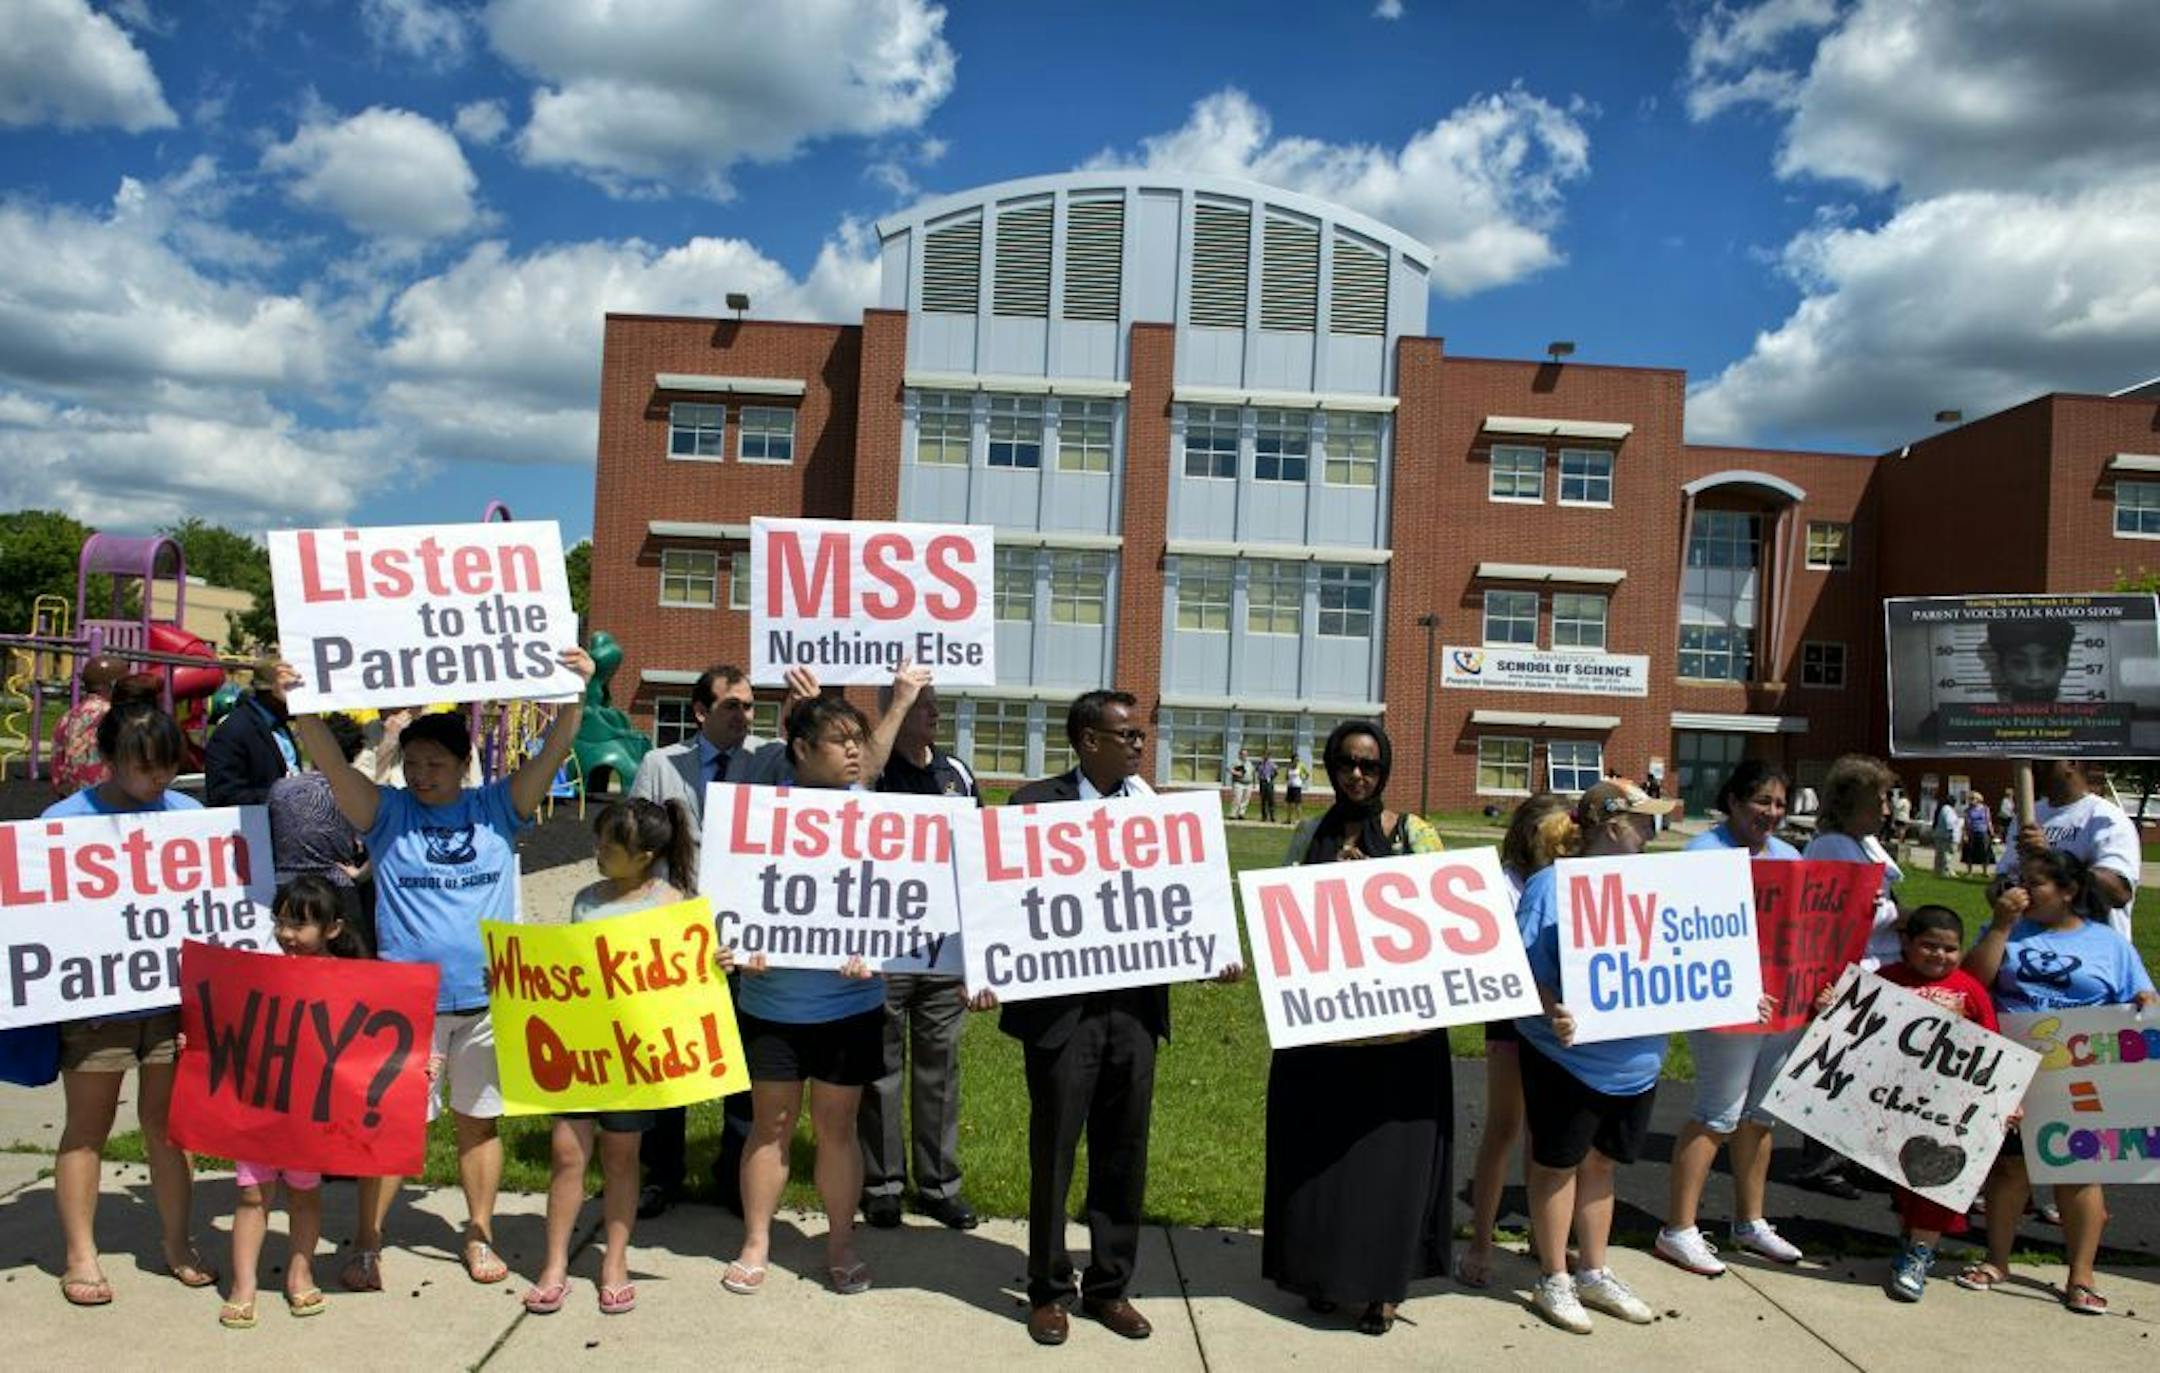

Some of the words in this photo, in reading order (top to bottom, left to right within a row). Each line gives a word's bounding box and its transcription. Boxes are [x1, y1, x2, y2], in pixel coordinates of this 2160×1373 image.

[297, 530, 542, 603] Listen
[767, 531, 978, 621] MSS
[418, 602, 465, 638] to
[475, 594, 548, 635] the
[1911, 609, 1960, 621] PARENT
[1963, 608, 2008, 619] VOICES
[2010, 607, 2042, 618] TALK
[2044, 607, 2086, 618] RADIO
[2087, 606, 2124, 617] SHOW
[312, 634, 556, 694] Parents
[768, 630, 904, 673] Nothing
[915, 631, 984, 665] Else
[1497, 659, 1551, 673] SCHOOL
[1555, 663, 1571, 673] OF
[1575, 663, 1631, 677] SCIENCE
[730, 783, 950, 863] Listen
[981, 803, 1206, 882] Listen
[0, 823, 250, 907] Listen
[758, 863, 817, 916] to
[833, 860, 929, 920] the
[122, 902, 169, 941] to
[182, 890, 256, 935] the
[715, 910, 945, 969] Community
[1020, 886, 1083, 941] to
[1095, 870, 1193, 934] the
[1258, 864, 1500, 978] MSS
[1569, 873, 1657, 962] My
[1661, 902, 1748, 944] School
[8, 933, 259, 1008] Pare
[487, 931, 591, 1002] Whose
[984, 926, 1217, 986] Community
[1588, 947, 1733, 1012] Choice
[1280, 978, 1438, 1028] Nothing
[1442, 967, 1523, 1008] Else
[196, 979, 415, 1129] WHY?
[525, 1014, 613, 1093] Our
[1788, 1035, 1855, 1100] My
[1821, 974, 1888, 1050] My
[1897, 1016, 2004, 1095] Child,
